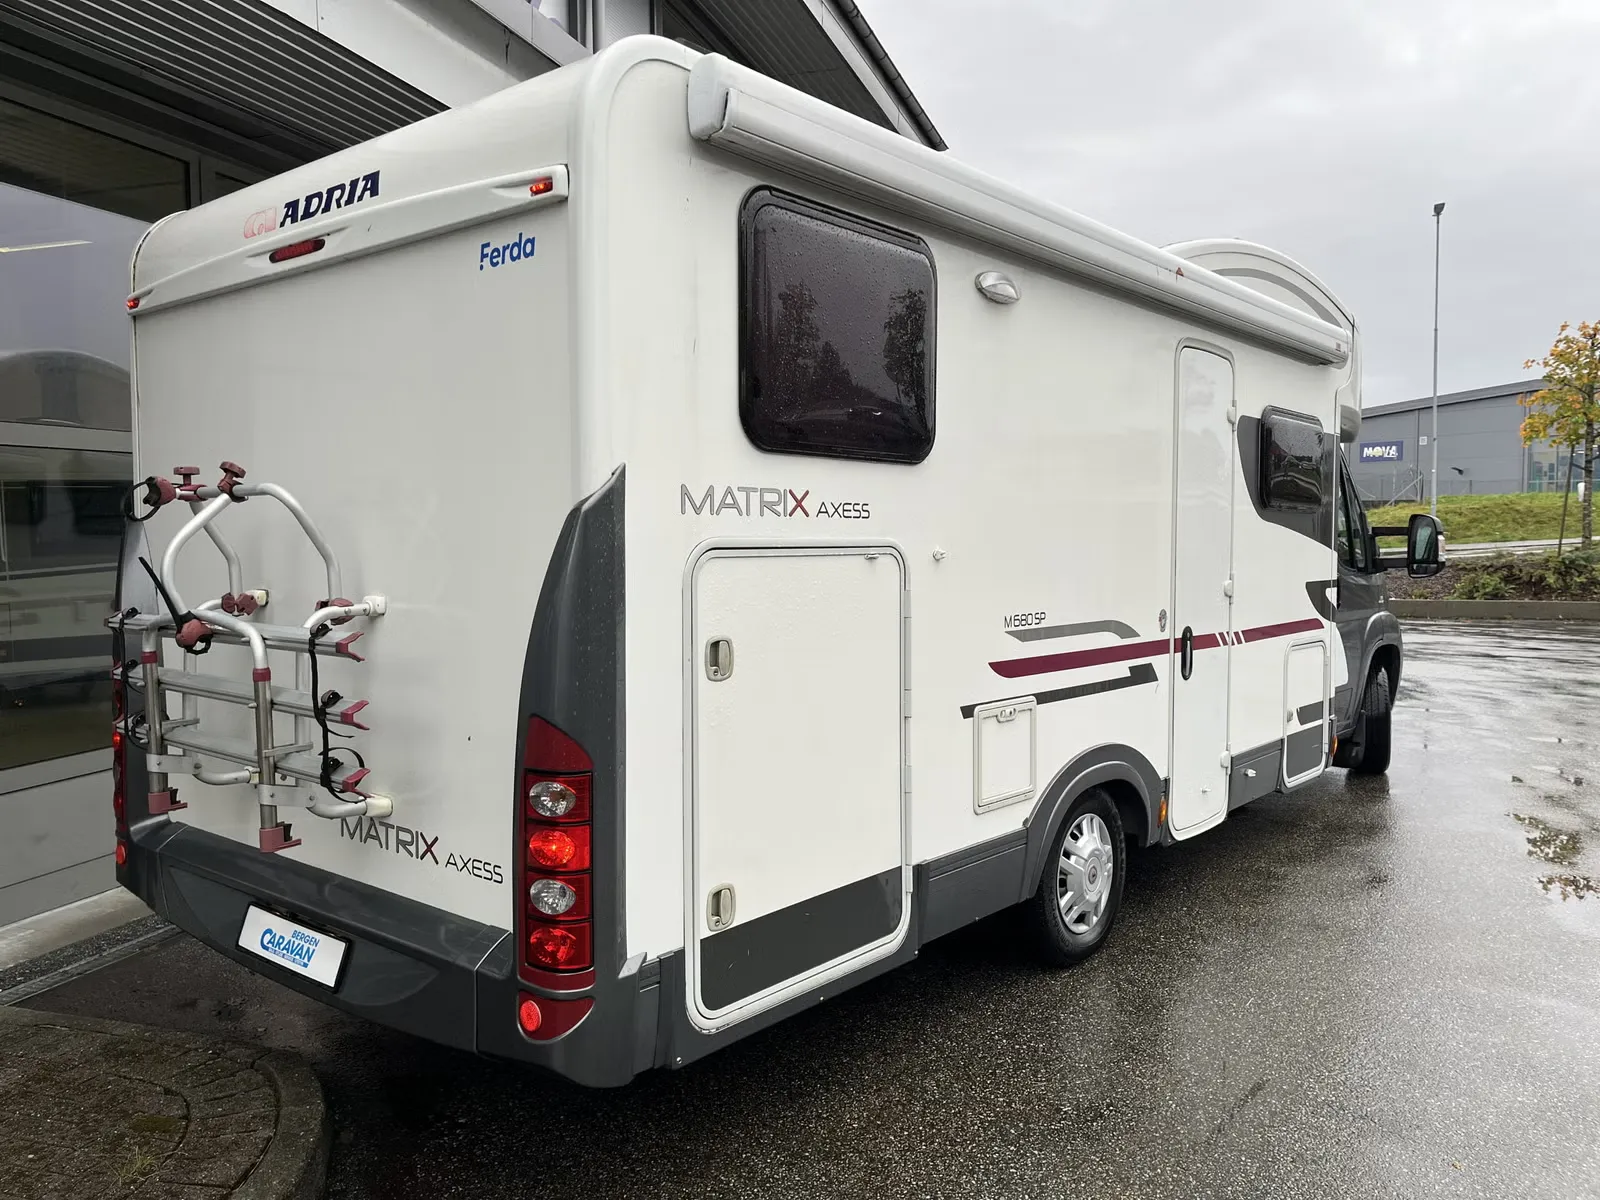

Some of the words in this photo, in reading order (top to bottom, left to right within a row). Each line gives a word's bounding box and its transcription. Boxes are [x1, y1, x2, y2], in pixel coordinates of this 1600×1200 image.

[280, 170, 380, 227] ADRIA
[479, 232, 536, 270] Ferda
[680, 483, 810, 517] MATRIX
[816, 501, 870, 519] AXESS
[340, 815, 439, 865] MATRIX
[445, 852, 503, 884] AXESS
[260, 928, 316, 962] CARAVAN
[291, 930, 320, 947] BERGEN
